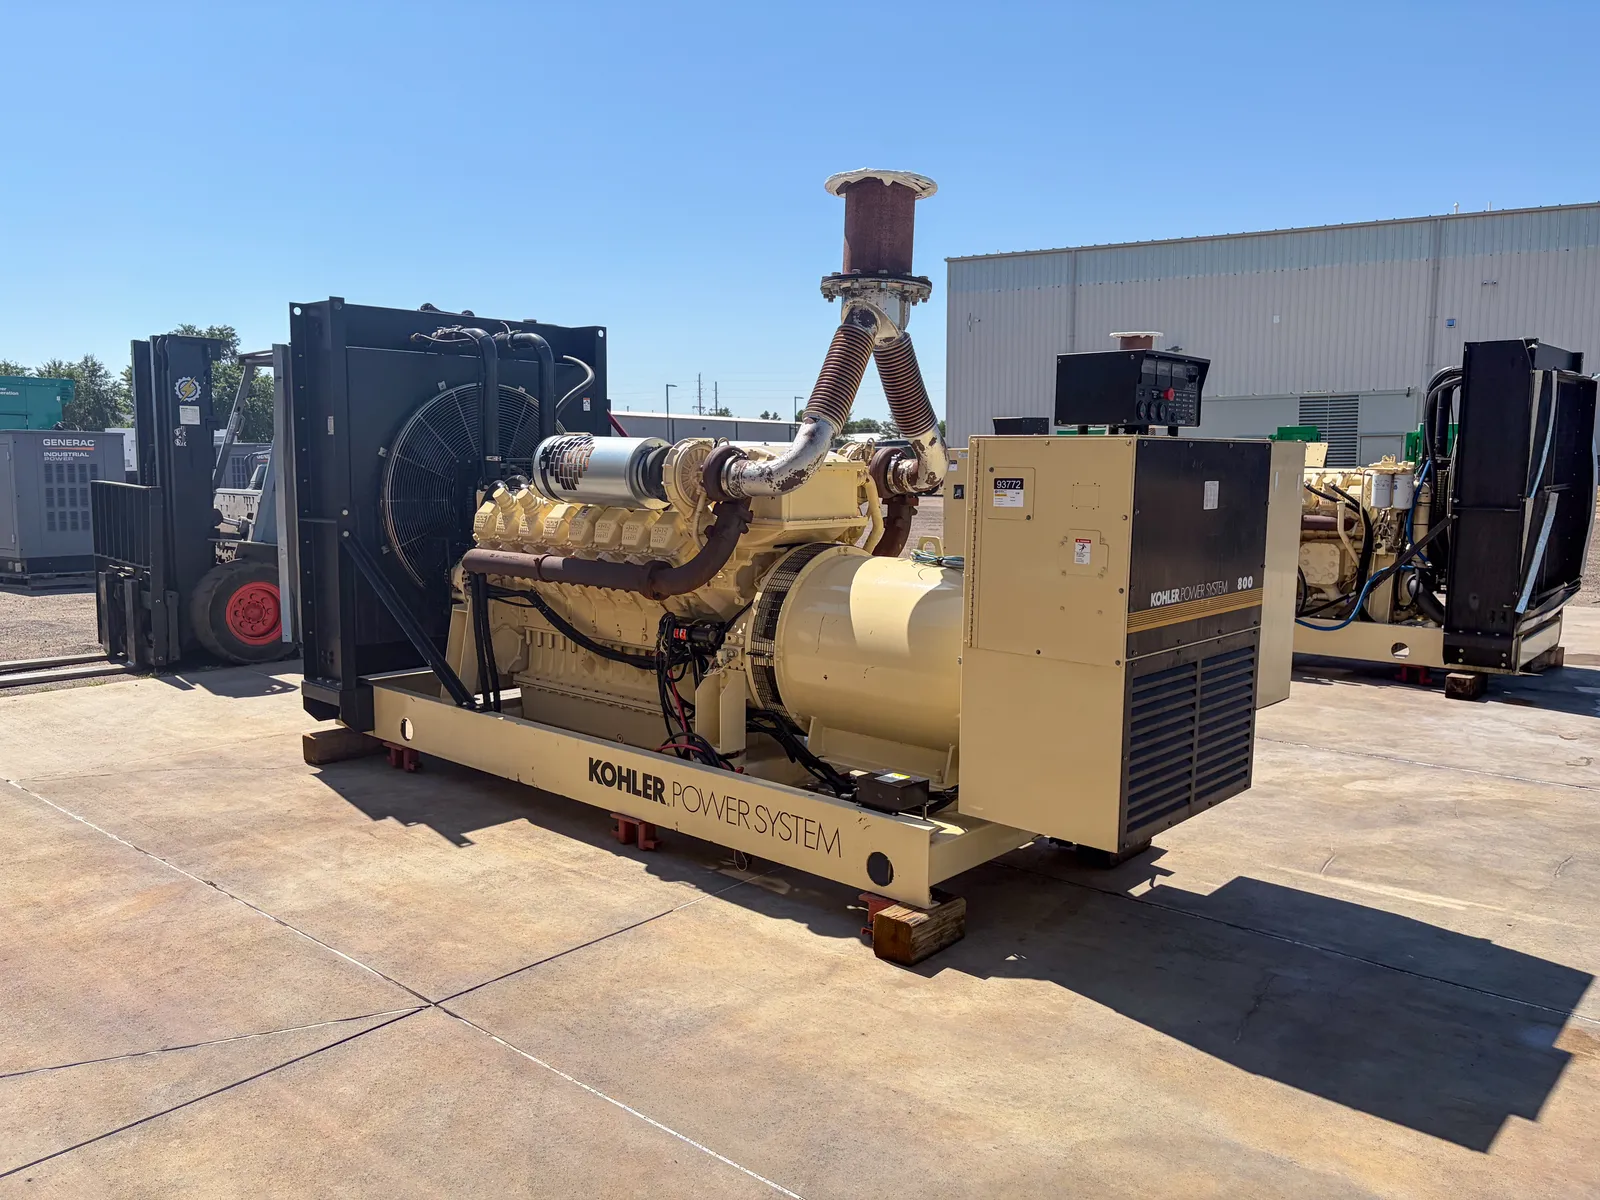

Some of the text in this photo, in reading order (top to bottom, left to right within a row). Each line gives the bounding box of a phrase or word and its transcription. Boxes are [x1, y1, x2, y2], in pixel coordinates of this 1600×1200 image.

[996, 480, 1021, 489] 93772
[1150, 576, 1253, 607] KOHLER POWER SYSTEM 800
[588, 756, 842, 859] KOHLER POWER SYSTEM
